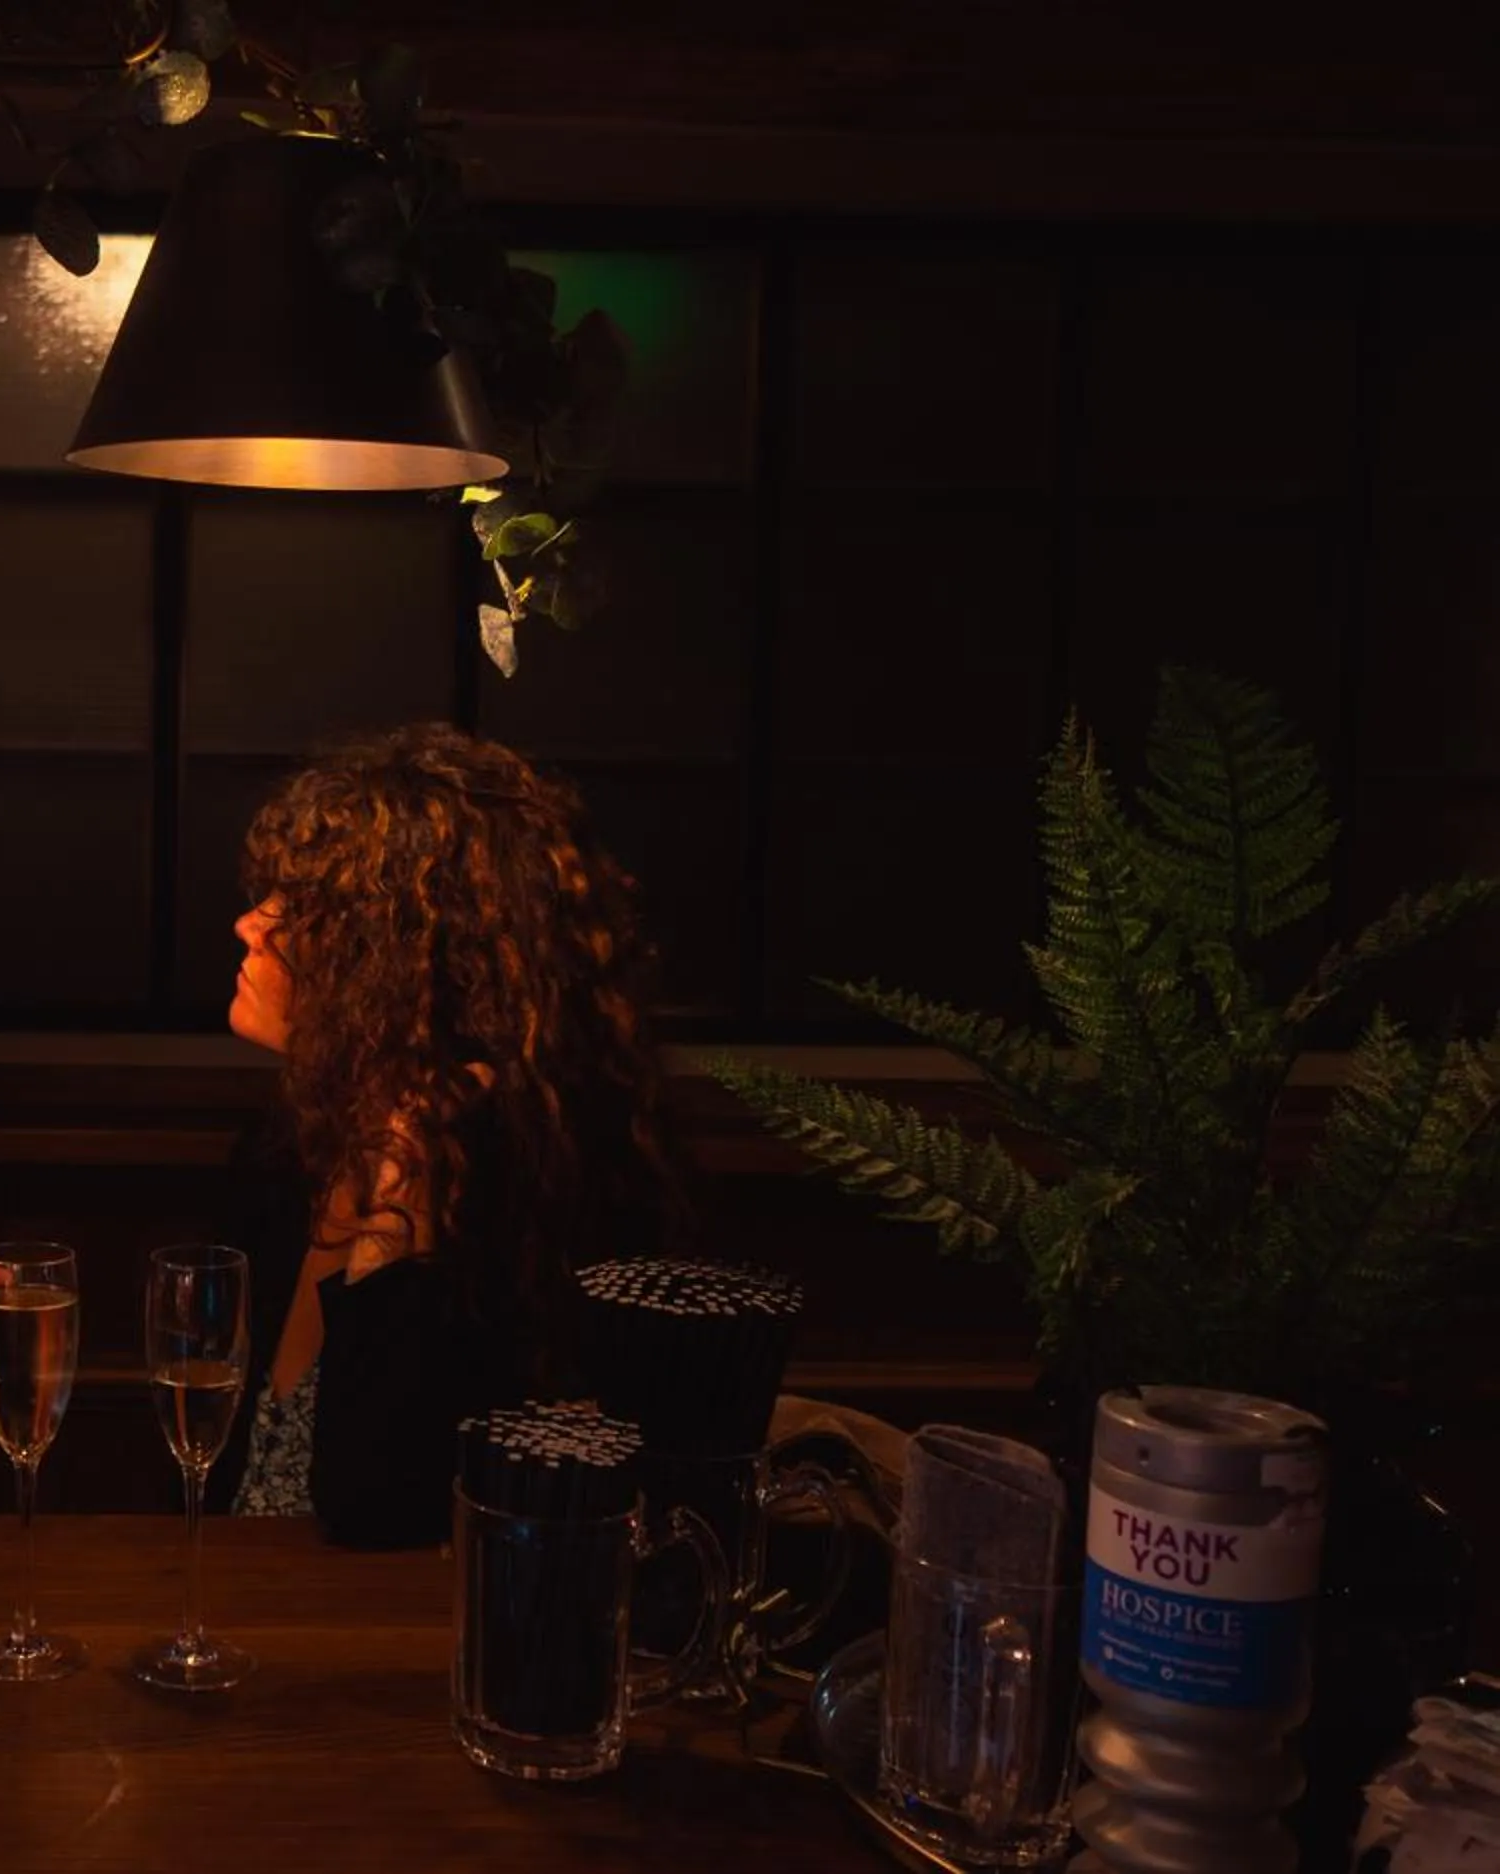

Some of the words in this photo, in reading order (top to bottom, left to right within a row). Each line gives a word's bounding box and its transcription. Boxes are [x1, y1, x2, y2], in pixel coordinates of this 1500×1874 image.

[1112, 1509, 1241, 1562] THANK
[1130, 1545, 1212, 1587] YOU
[1101, 1579, 1242, 1636] HOSPICE
